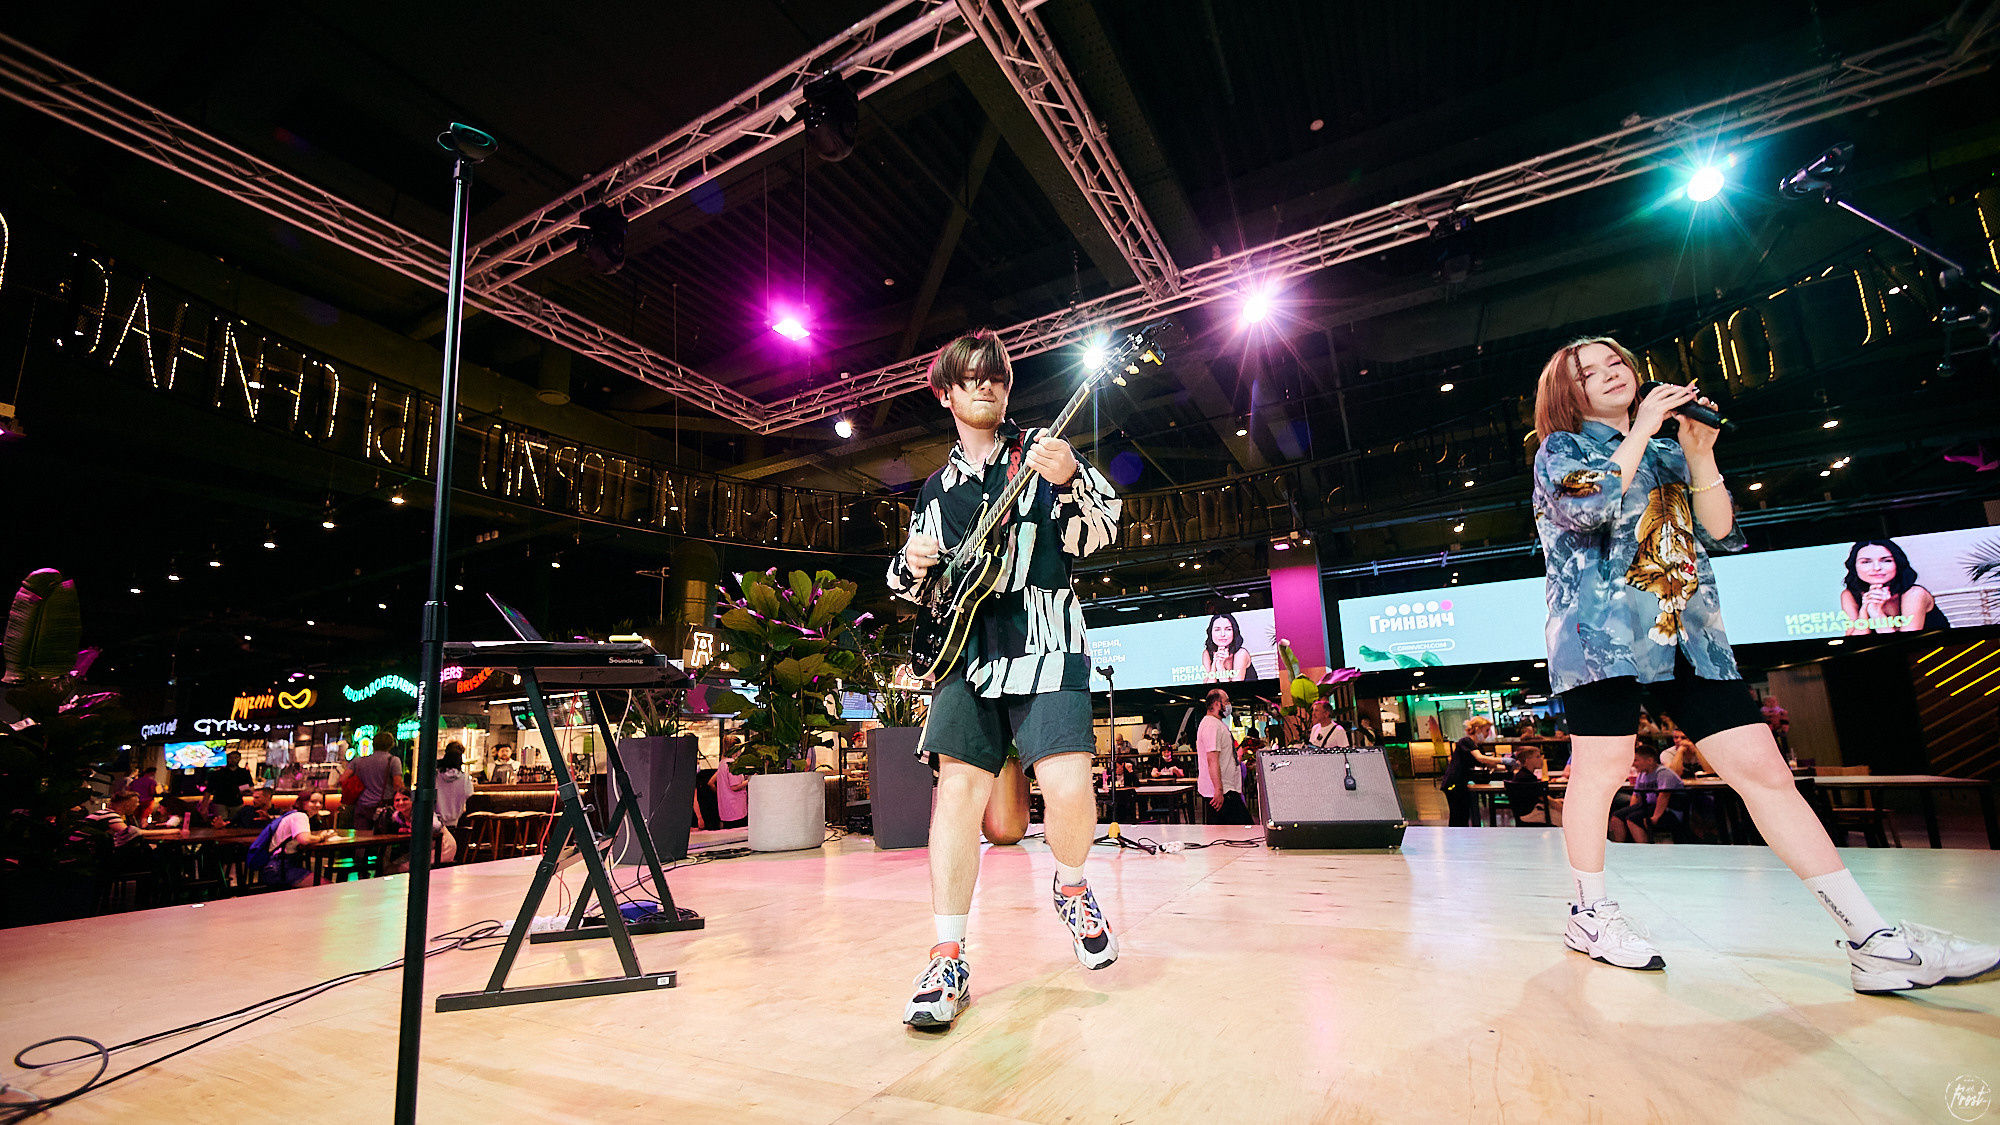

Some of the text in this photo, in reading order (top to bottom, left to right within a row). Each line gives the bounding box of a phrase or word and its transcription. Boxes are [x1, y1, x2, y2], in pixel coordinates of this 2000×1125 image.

[1784, 610, 1850, 625] ИРЕНА
[1786, 615, 1914, 635] ПОНАРОШКУ
[1092, 639, 1122, 649] ВРЕМЯ,
[1092, 655, 1126, 665] ТОВАРЫ
[1171, 665, 1206, 675] ИРЕНА
[1172, 669, 1240, 682] ПОНАРОШКУ
